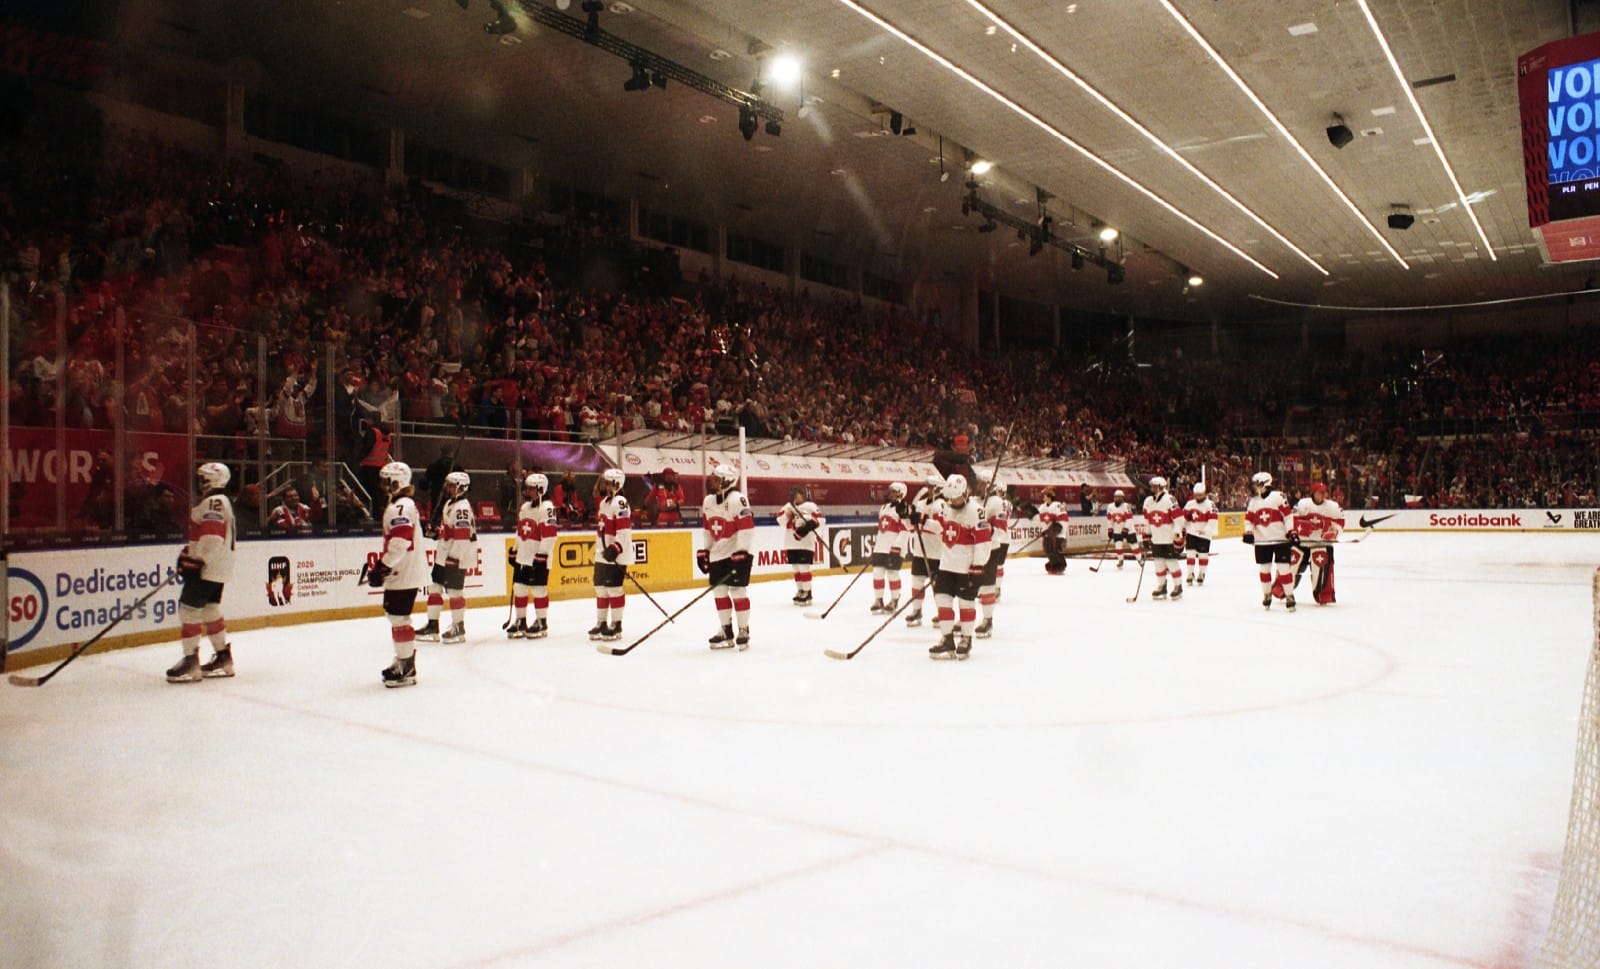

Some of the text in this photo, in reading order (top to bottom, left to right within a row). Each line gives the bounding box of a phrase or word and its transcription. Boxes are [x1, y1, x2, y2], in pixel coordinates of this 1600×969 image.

[209, 499, 222, 511] 12
[396, 504, 404, 516] 7
[456, 509, 469, 520] 25
[1429, 513, 1521, 526] Scotiabank
[1574, 511, 1585, 519] WE
[1023, 527, 1043, 539] TISS
[1079, 524, 1101, 535] TISSOT
[833, 529, 852, 565] G
[56, 564, 184, 597] Dedicated to
[297, 576, 342, 584] CHAMPIONSHIP
[560, 575, 589, 585] Service,
[56, 597, 181, 631] Canada's ga
